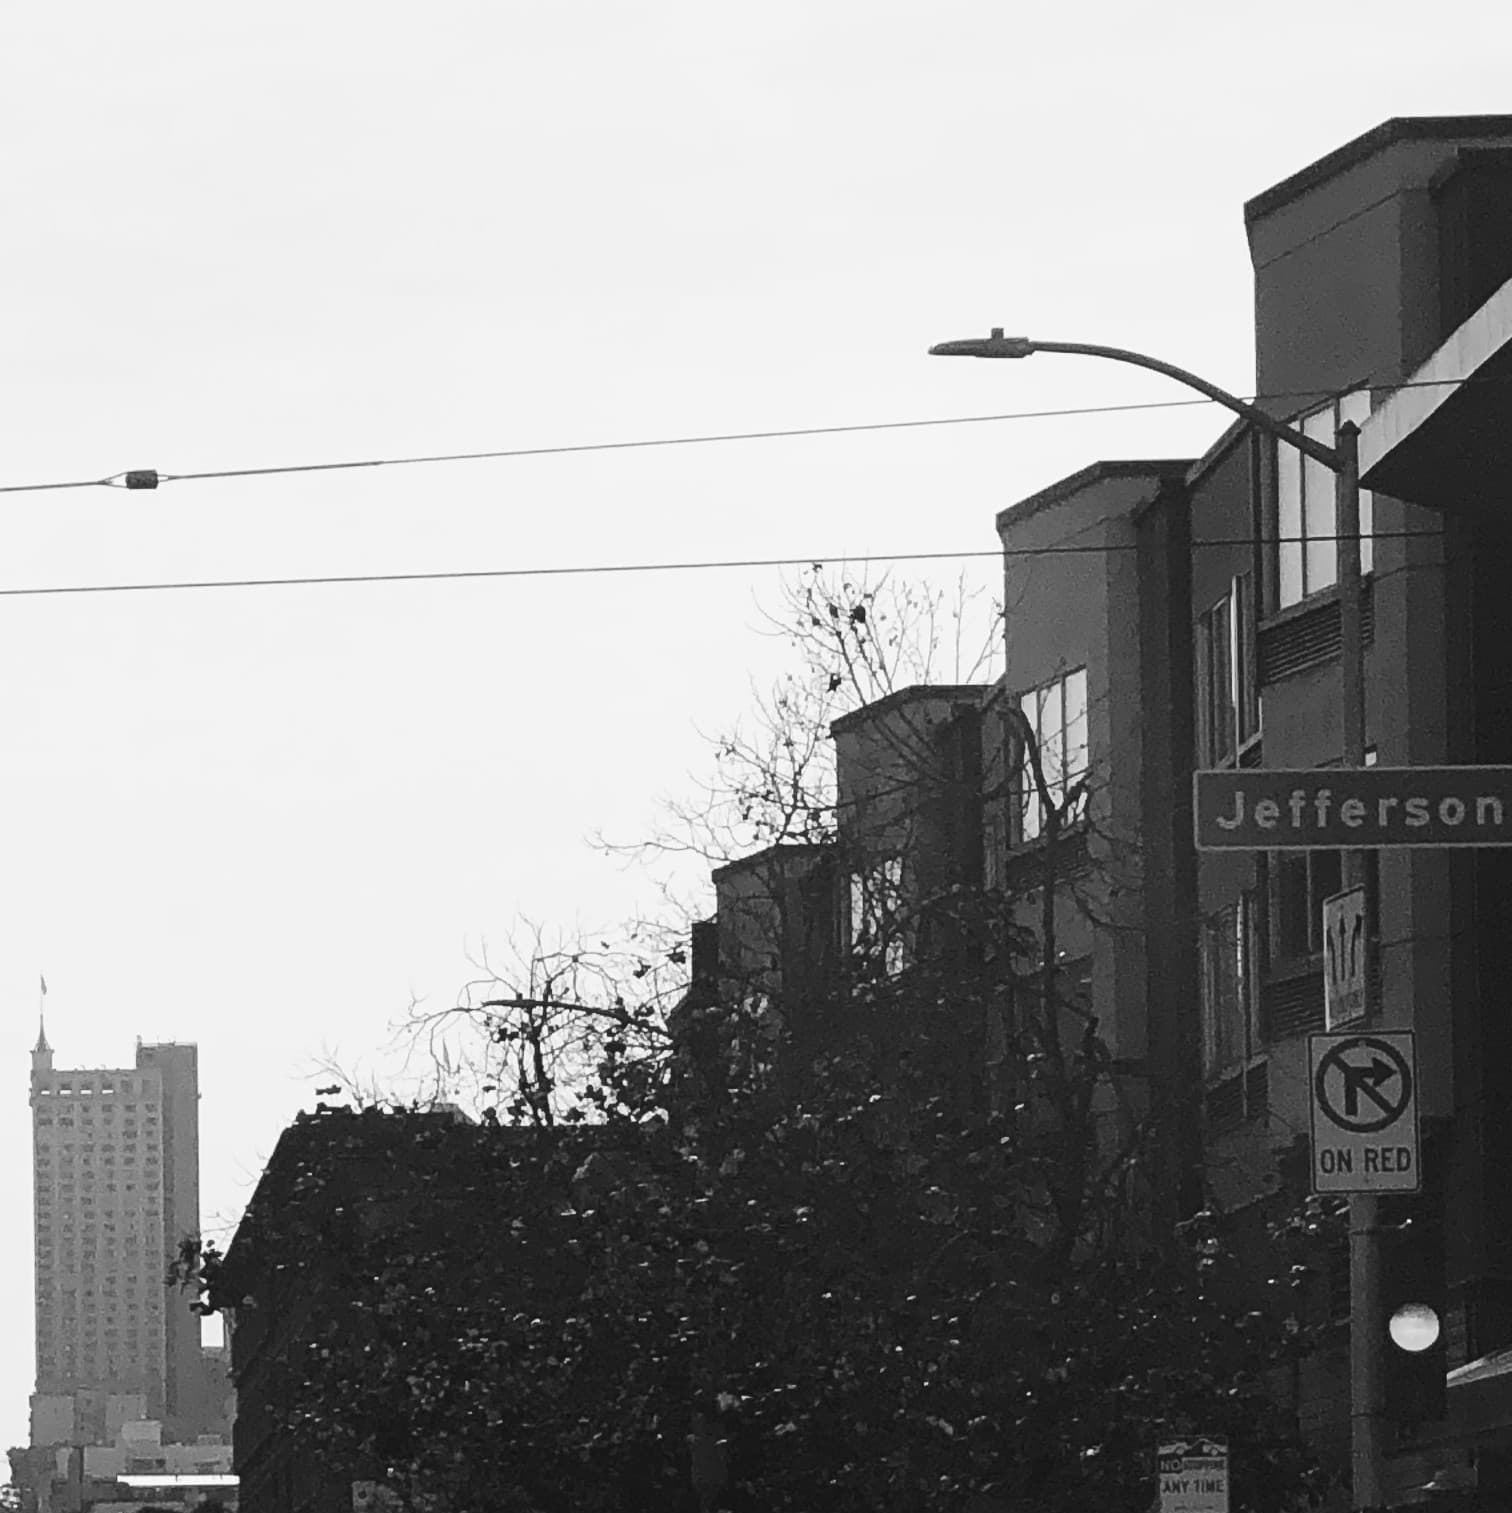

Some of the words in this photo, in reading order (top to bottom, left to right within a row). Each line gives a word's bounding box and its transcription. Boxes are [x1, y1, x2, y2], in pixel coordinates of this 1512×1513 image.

[1216, 788, 1504, 830] Jefferson
[1321, 1149, 1352, 1174] ON
[1364, 1147, 1411, 1173] RED
[1159, 1458, 1180, 1471] NO
[1163, 1480, 1189, 1494] ANY
[1194, 1480, 1225, 1494] TIME
